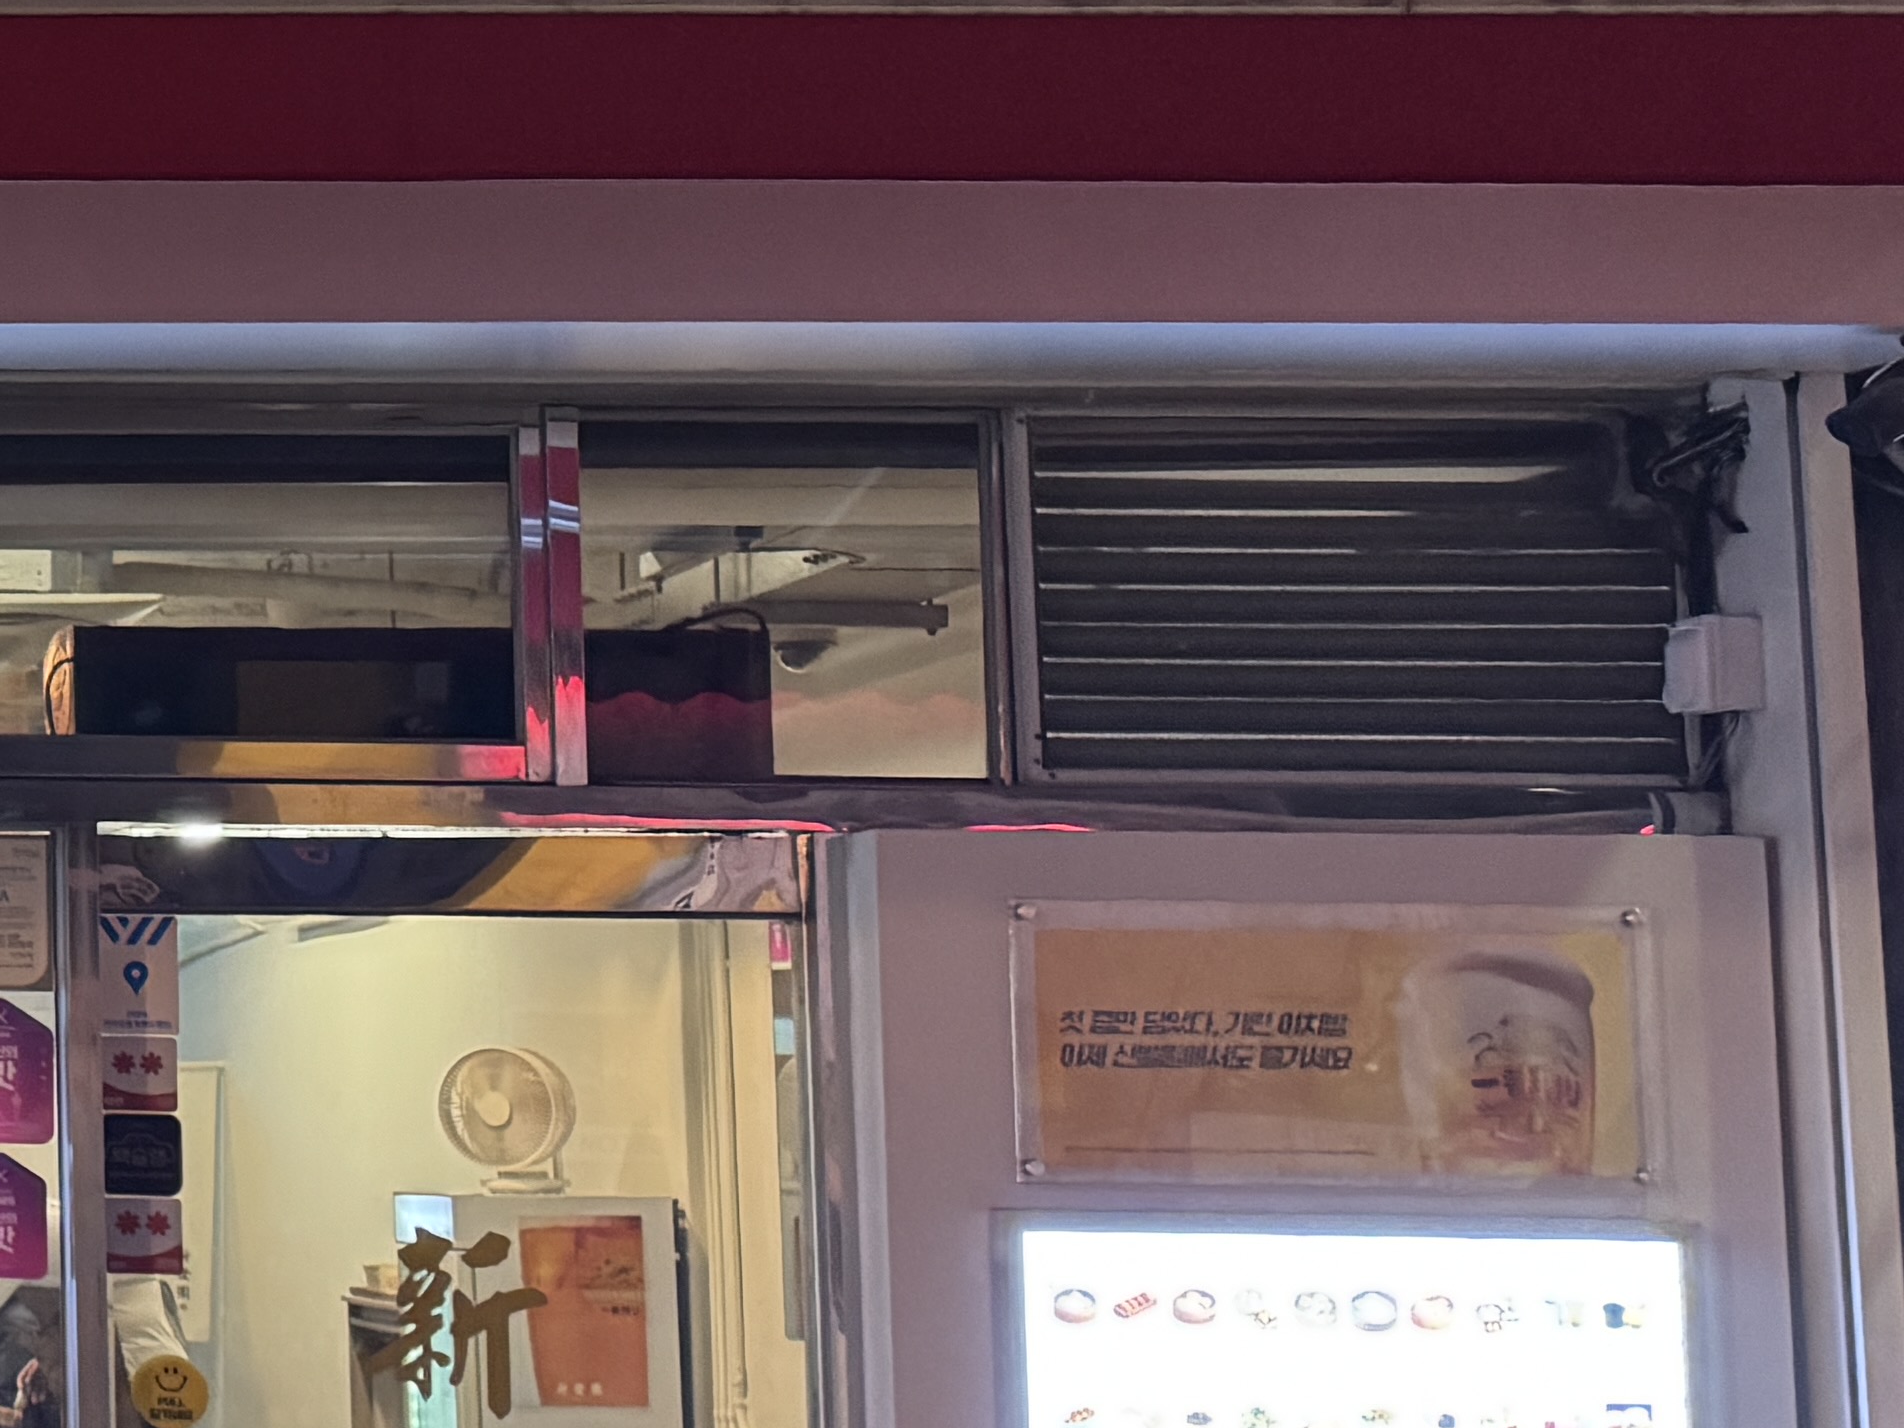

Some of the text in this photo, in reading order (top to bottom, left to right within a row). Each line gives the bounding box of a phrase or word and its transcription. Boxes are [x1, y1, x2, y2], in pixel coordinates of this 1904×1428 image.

[1059, 1009, 1085, 1035] 첫
[1222, 1010, 1273, 1037] 기린
[1059, 1042, 1107, 1069] 이제
